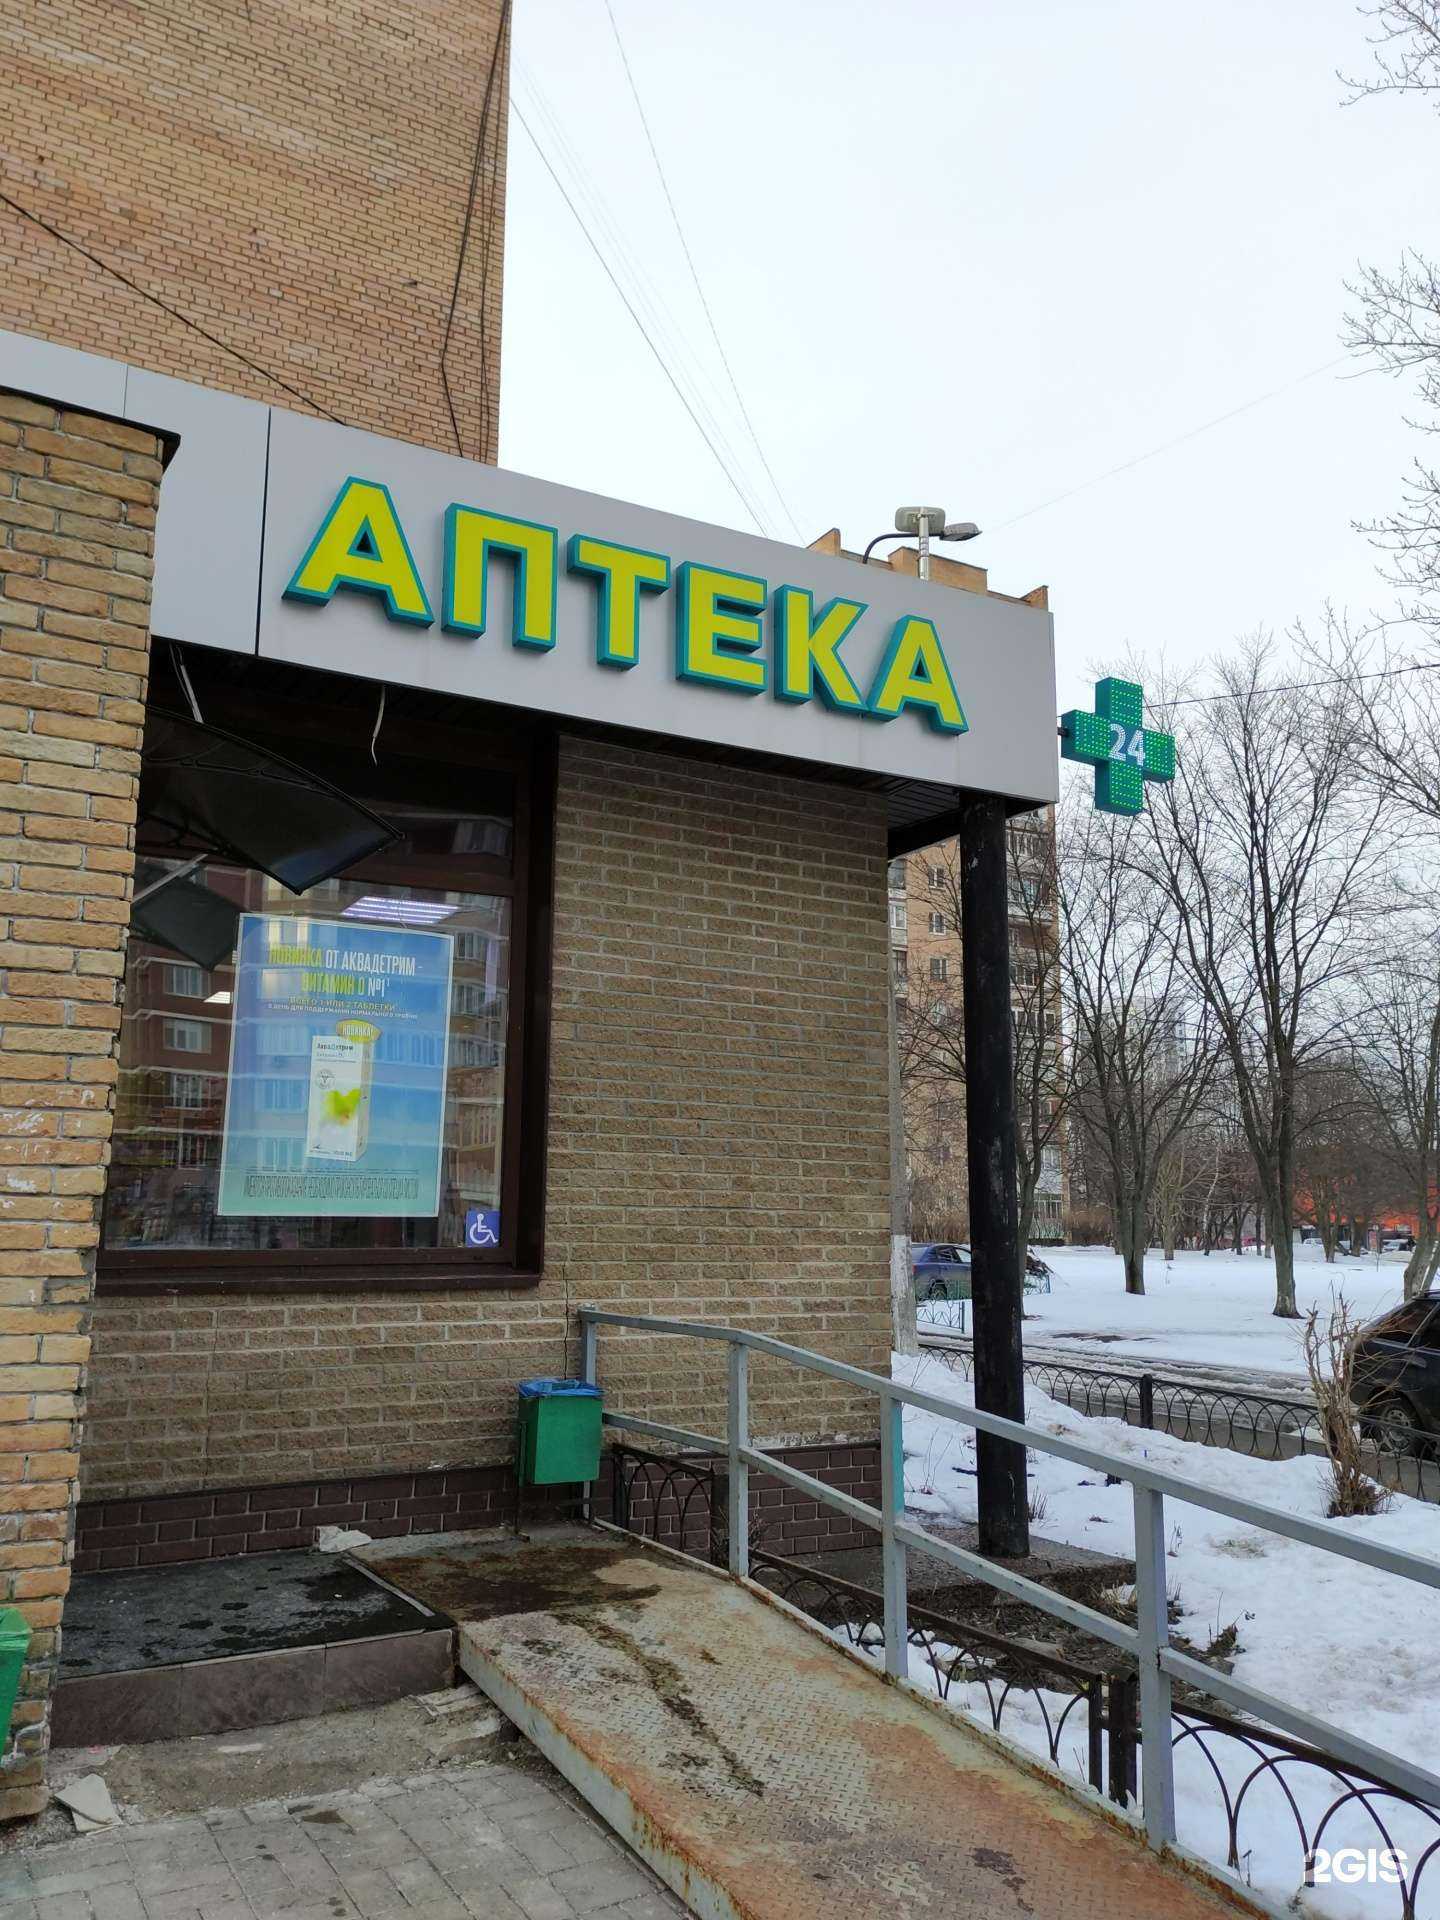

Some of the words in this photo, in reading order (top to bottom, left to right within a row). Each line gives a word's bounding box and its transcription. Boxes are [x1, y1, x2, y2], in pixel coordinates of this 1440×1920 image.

[281, 475, 969, 736] АПТЕКА
[1108, 723, 1146, 766] 24
[268, 944, 322, 968] НОВИНКА
[325, 949, 340, 969] ОТ
[341, 951, 416, 976] АКВАДЕТРИМ
[301, 972, 354, 996] ВИТАМИН
